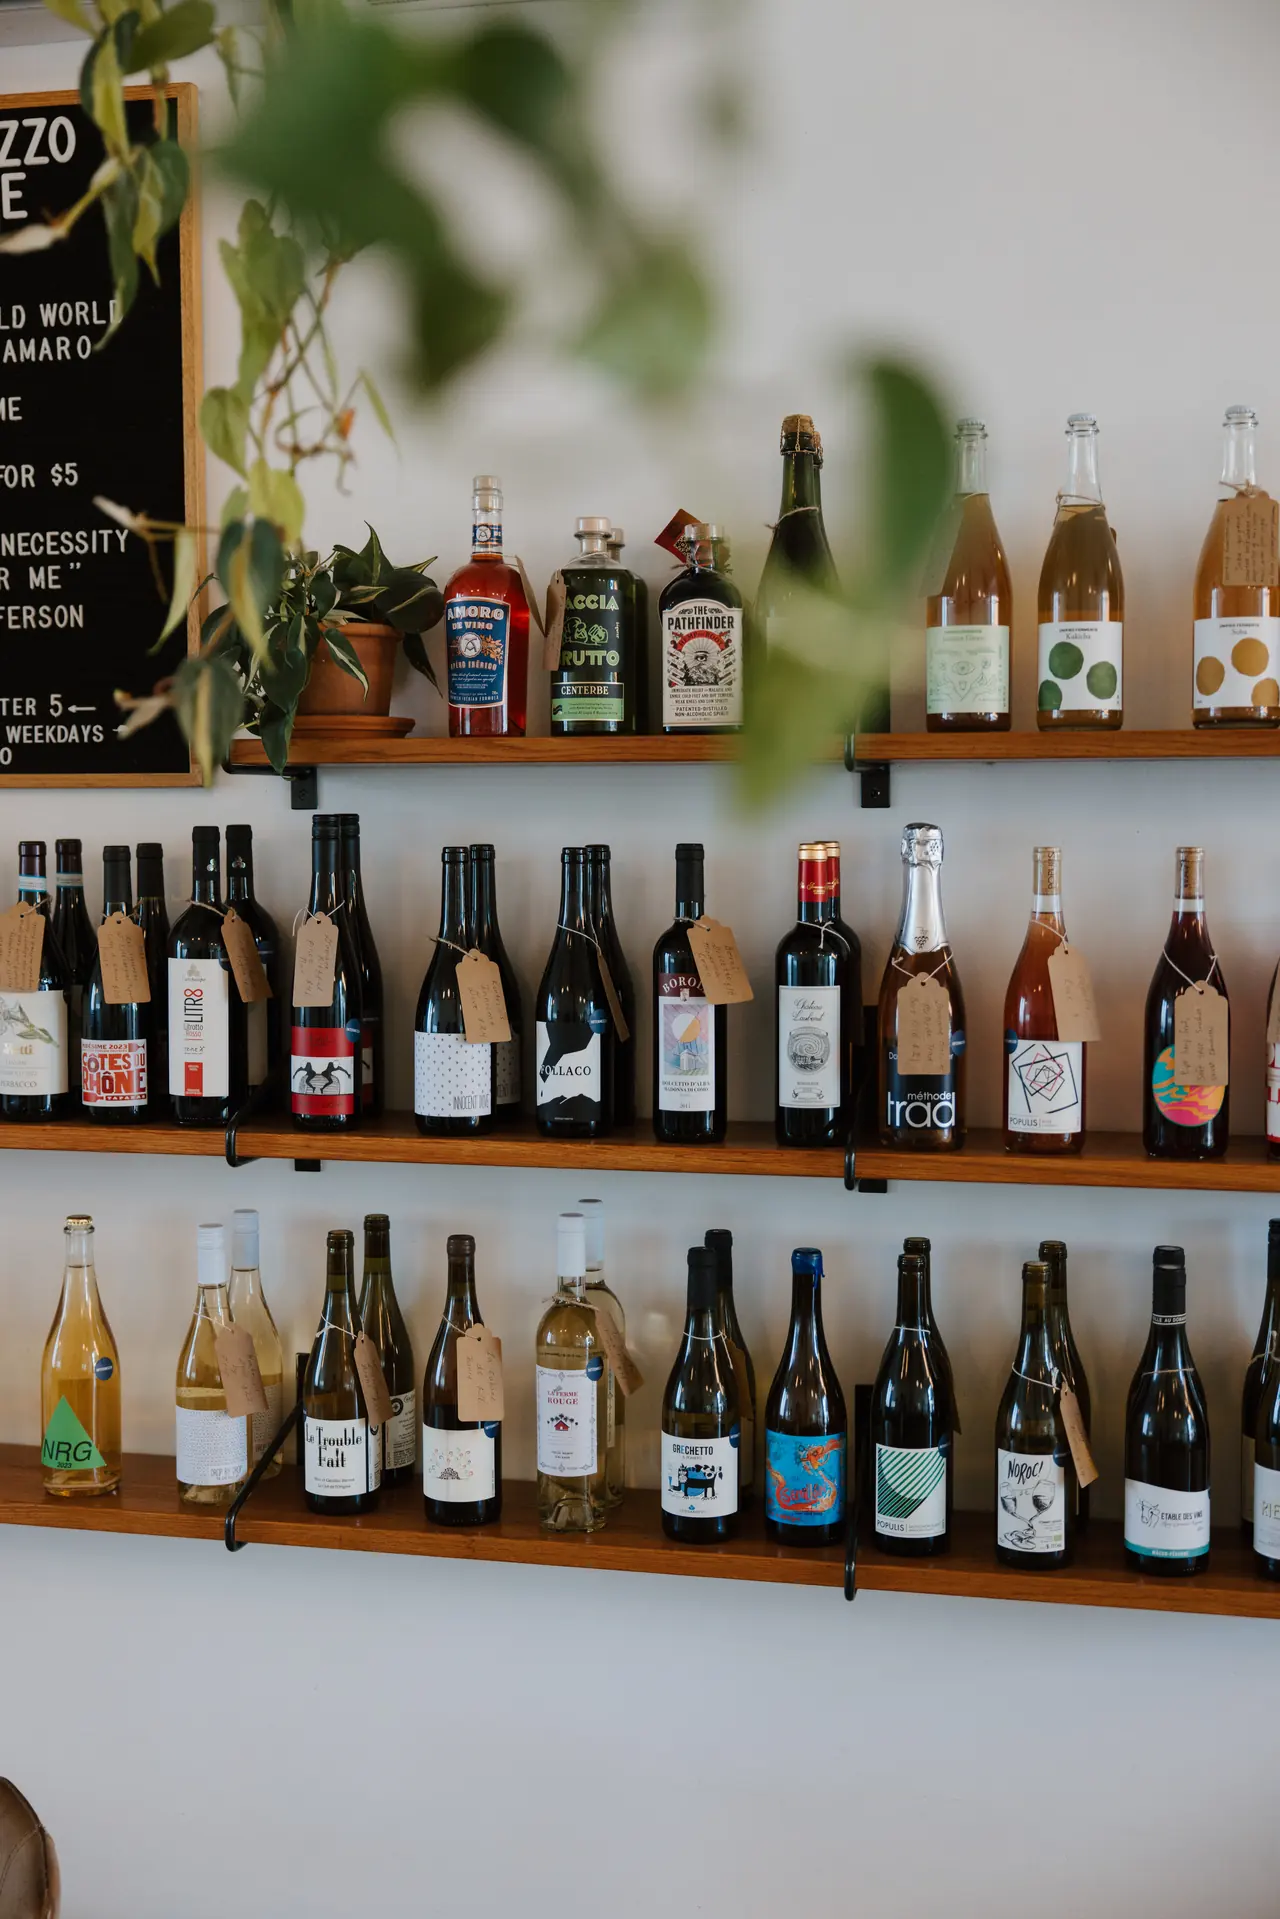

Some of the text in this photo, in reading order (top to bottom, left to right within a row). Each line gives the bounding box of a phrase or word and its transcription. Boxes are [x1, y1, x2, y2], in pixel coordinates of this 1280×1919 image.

[1, 172, 28, 220] E
[3, 335, 91, 363] AMARO
[51, 463, 78, 487] $5
[1, 529, 129, 556] NECESSITY
[0, 605, 84, 629] ERSON
[447, 606, 504, 621] AMORO
[694, 606, 708, 615] THE
[464, 622, 494, 630] VINO
[668, 616, 734, 630] PATHFINDER
[561, 686, 609, 696] CENTERBE
[0, 693, 63, 717] TER 5
[6, 724, 104, 744] WEEKDAYS
[82, 1052, 145, 1073] CÔTES DU
[82, 1066, 146, 1096] RHÔNE
[908, 1091, 951, 1101] méthode
[888, 1092, 956, 1128] trad
[1010, 1117, 1038, 1127] POPULIS
[548, 1397, 578, 1405] ROUGE
[305, 1423, 362, 1446] Le Trouble
[43, 1438, 92, 1462] NRG
[318, 1446, 346, 1467] Fait
[673, 1443, 714, 1455] GRECHETTO
[1007, 1459, 1044, 1485] NOROC!
[877, 1519, 905, 1532] POPULIS
[1161, 1512, 1181, 1520] ETABLE
[1183, 1512, 1193, 1520] DES
